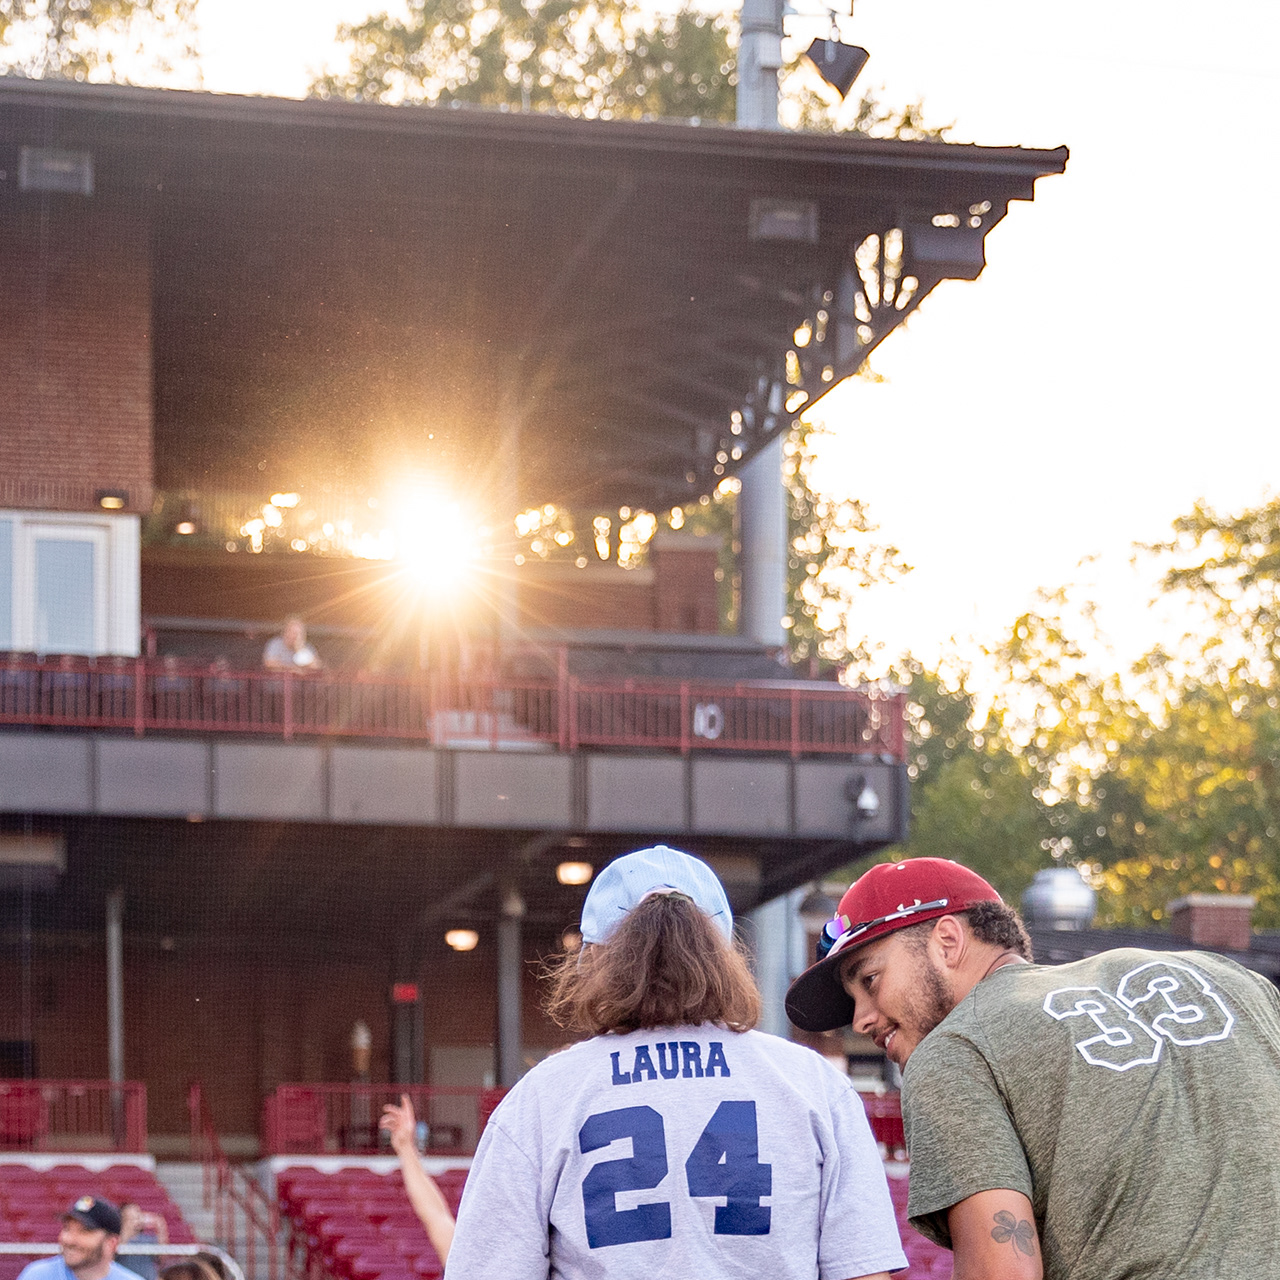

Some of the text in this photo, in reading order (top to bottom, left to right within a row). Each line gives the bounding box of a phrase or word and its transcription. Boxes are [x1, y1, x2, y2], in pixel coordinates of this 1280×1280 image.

[610, 1041, 730, 1085] LAURA
[1043, 961, 1235, 1072] 33
[578, 1100, 772, 1249] 24
